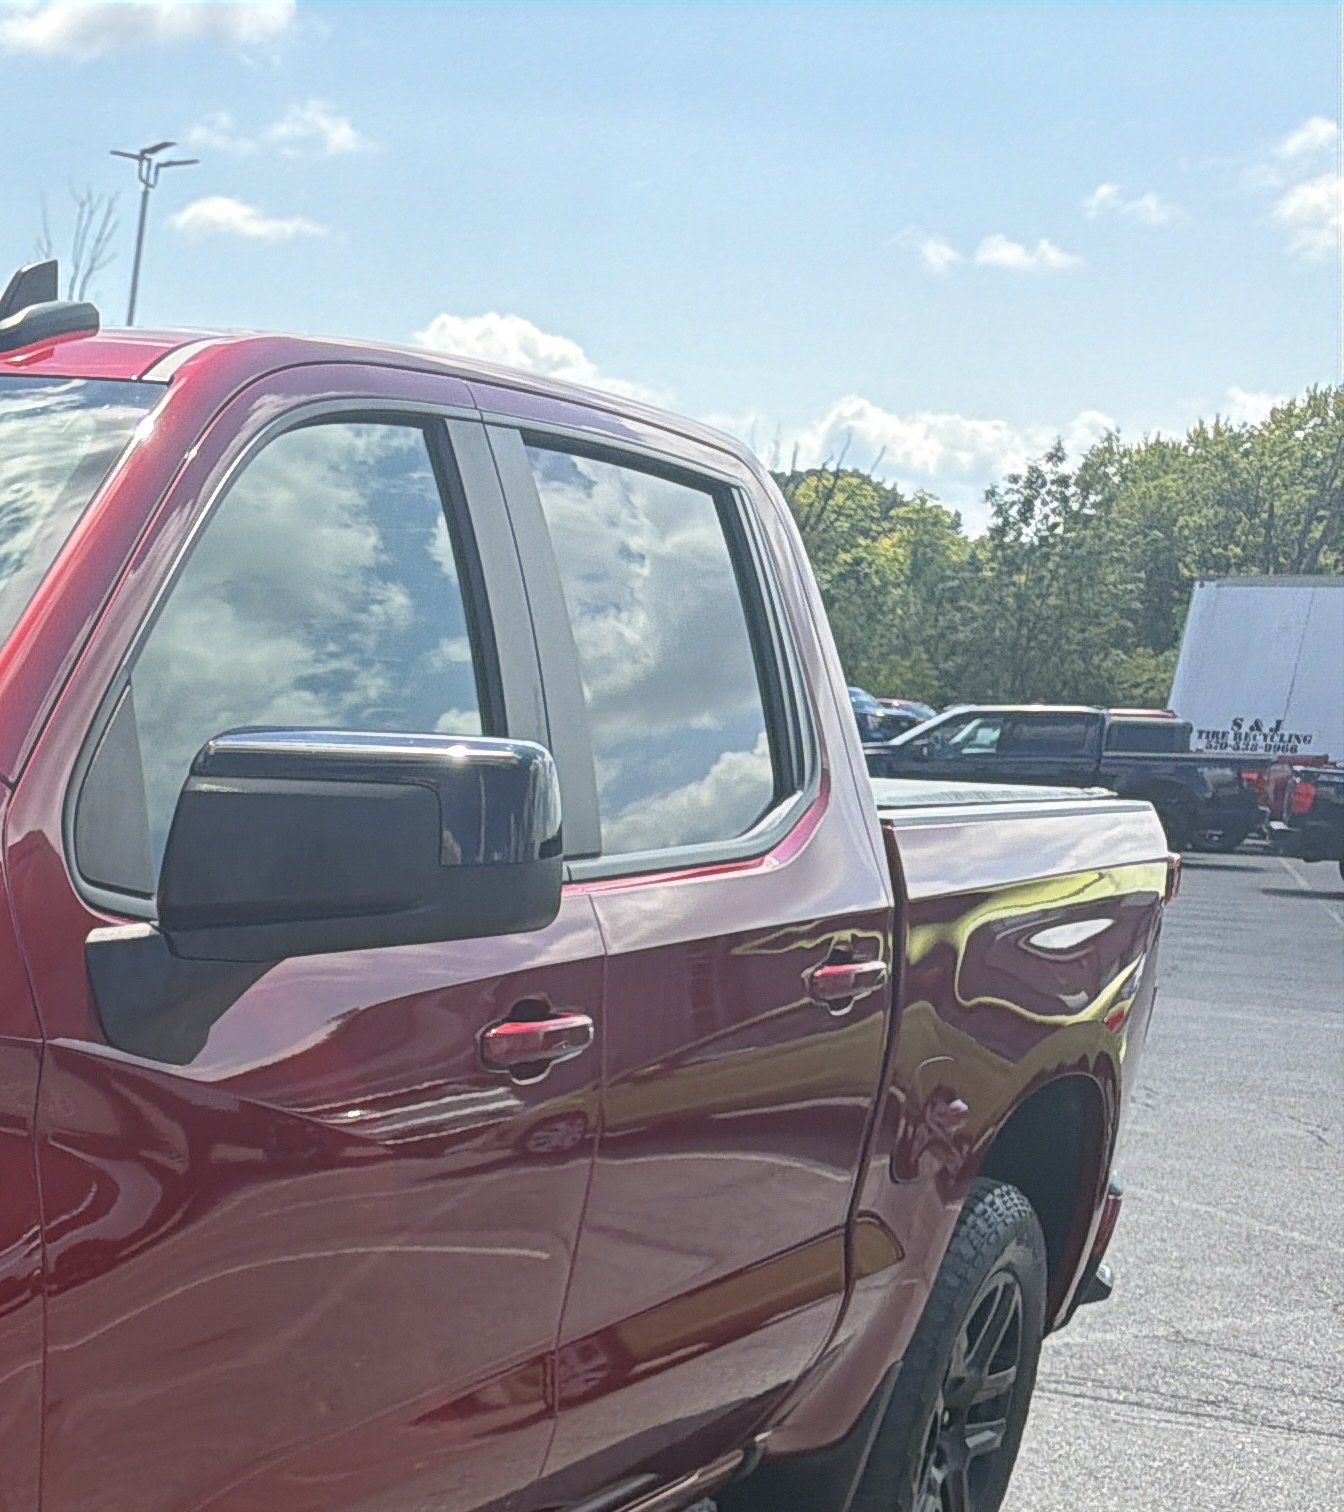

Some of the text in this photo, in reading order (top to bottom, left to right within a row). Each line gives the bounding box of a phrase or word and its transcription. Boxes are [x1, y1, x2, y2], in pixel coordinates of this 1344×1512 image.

[1232, 717, 1244, 731] S
[1197, 730, 1312, 744] TIRE RECYCLING
